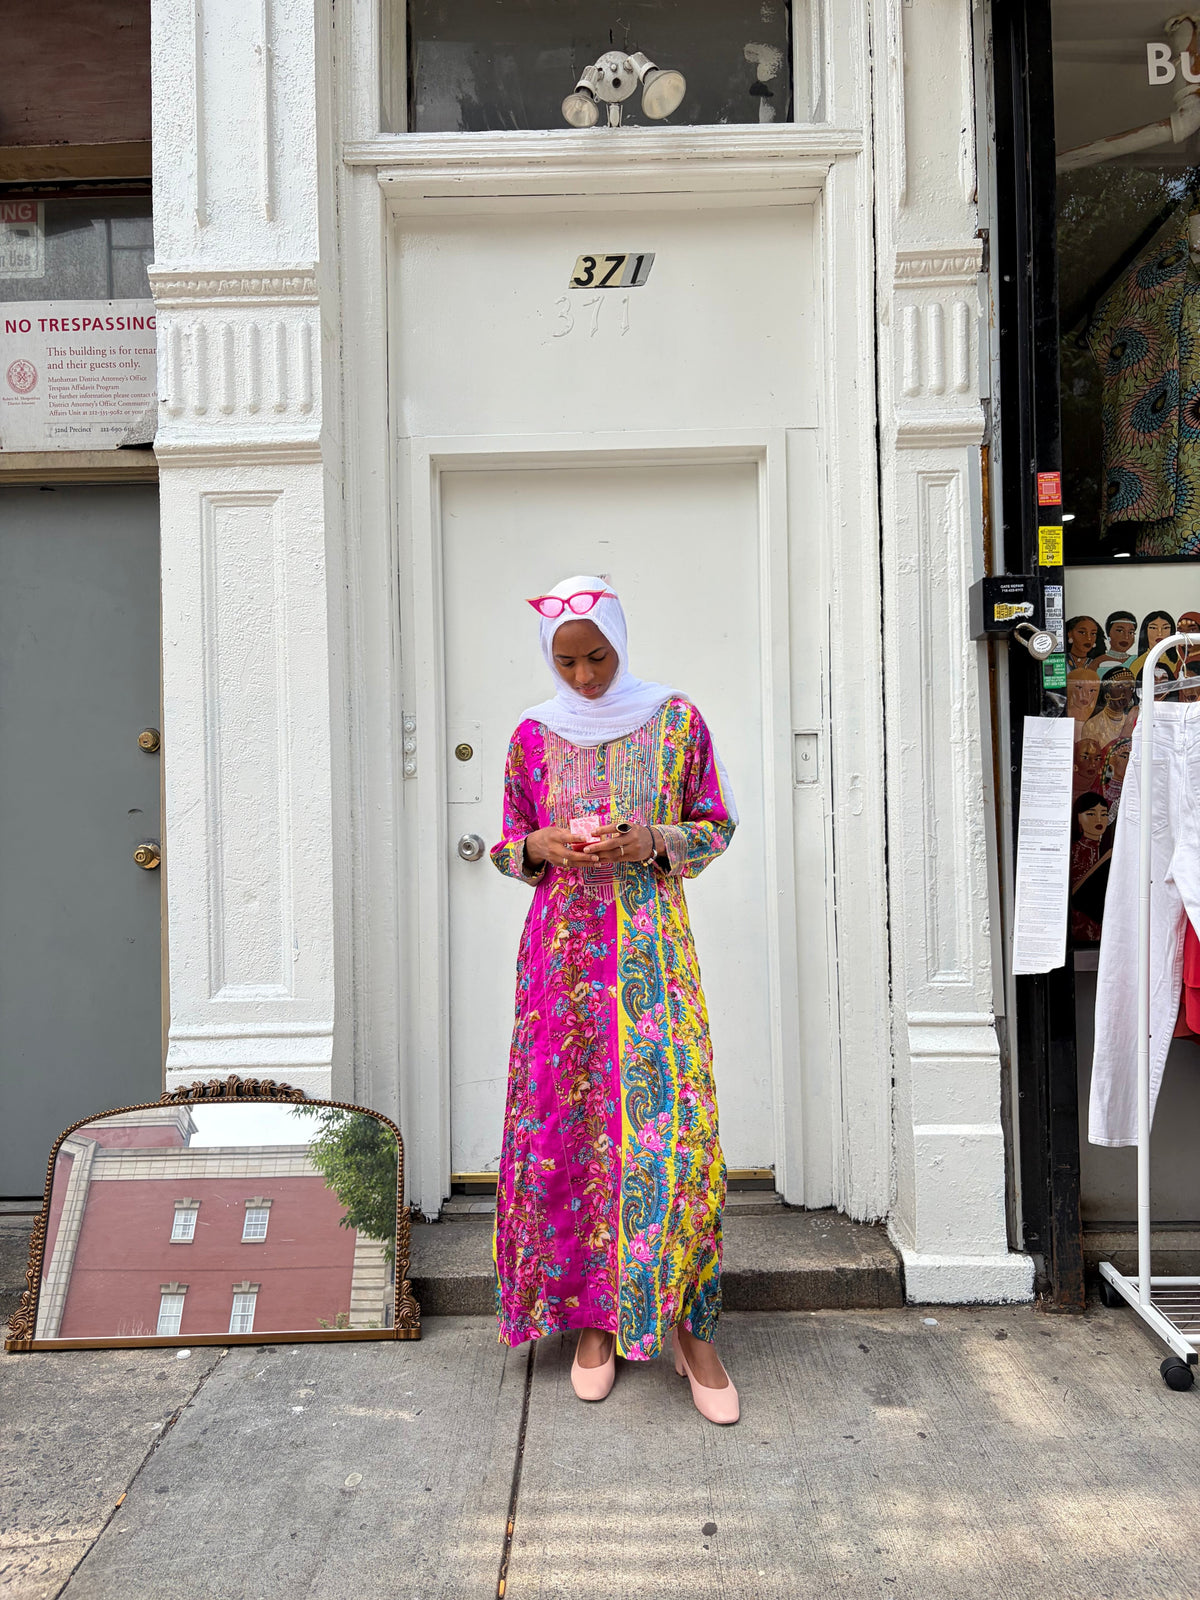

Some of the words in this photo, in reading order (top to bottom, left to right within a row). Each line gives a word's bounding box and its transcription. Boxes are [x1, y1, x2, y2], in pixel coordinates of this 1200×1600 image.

[574, 255, 644, 286] 371
[5, 319, 32, 333] NO
[38, 316, 156, 332] TRESPASSING
[47, 347, 67, 356] This
[69, 346, 107, 358] building
[109, 346, 116, 355] is
[119, 346, 132, 355] for
[47, 360, 64, 369] and
[66, 360, 87, 369] their
[89, 361, 117, 371] guests
[118, 359, 141, 371] only.
